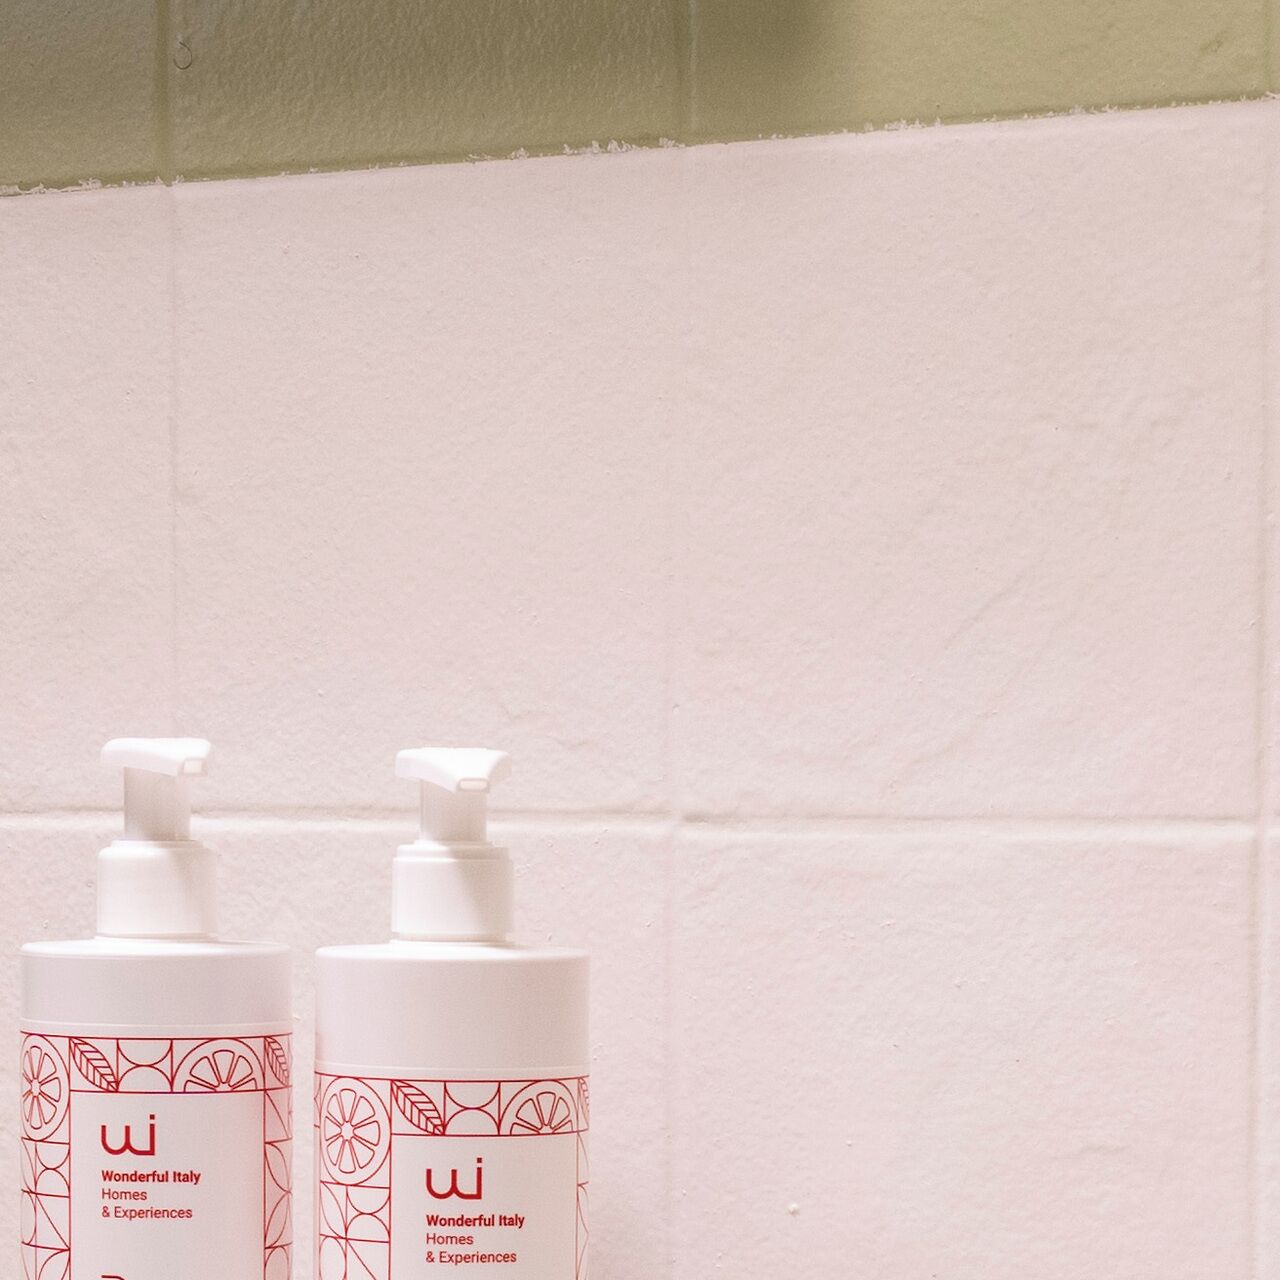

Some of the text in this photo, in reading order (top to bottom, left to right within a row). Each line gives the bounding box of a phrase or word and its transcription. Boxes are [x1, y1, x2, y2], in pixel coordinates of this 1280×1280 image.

[101, 1169, 202, 1185] Wonderful Italy
[101, 1188, 148, 1201] Homes
[101, 1205, 193, 1221] & Experiences
[426, 1213, 525, 1229] Wonderful Italy
[425, 1232, 474, 1246] Homes
[425, 1250, 517, 1265] & Experiences
